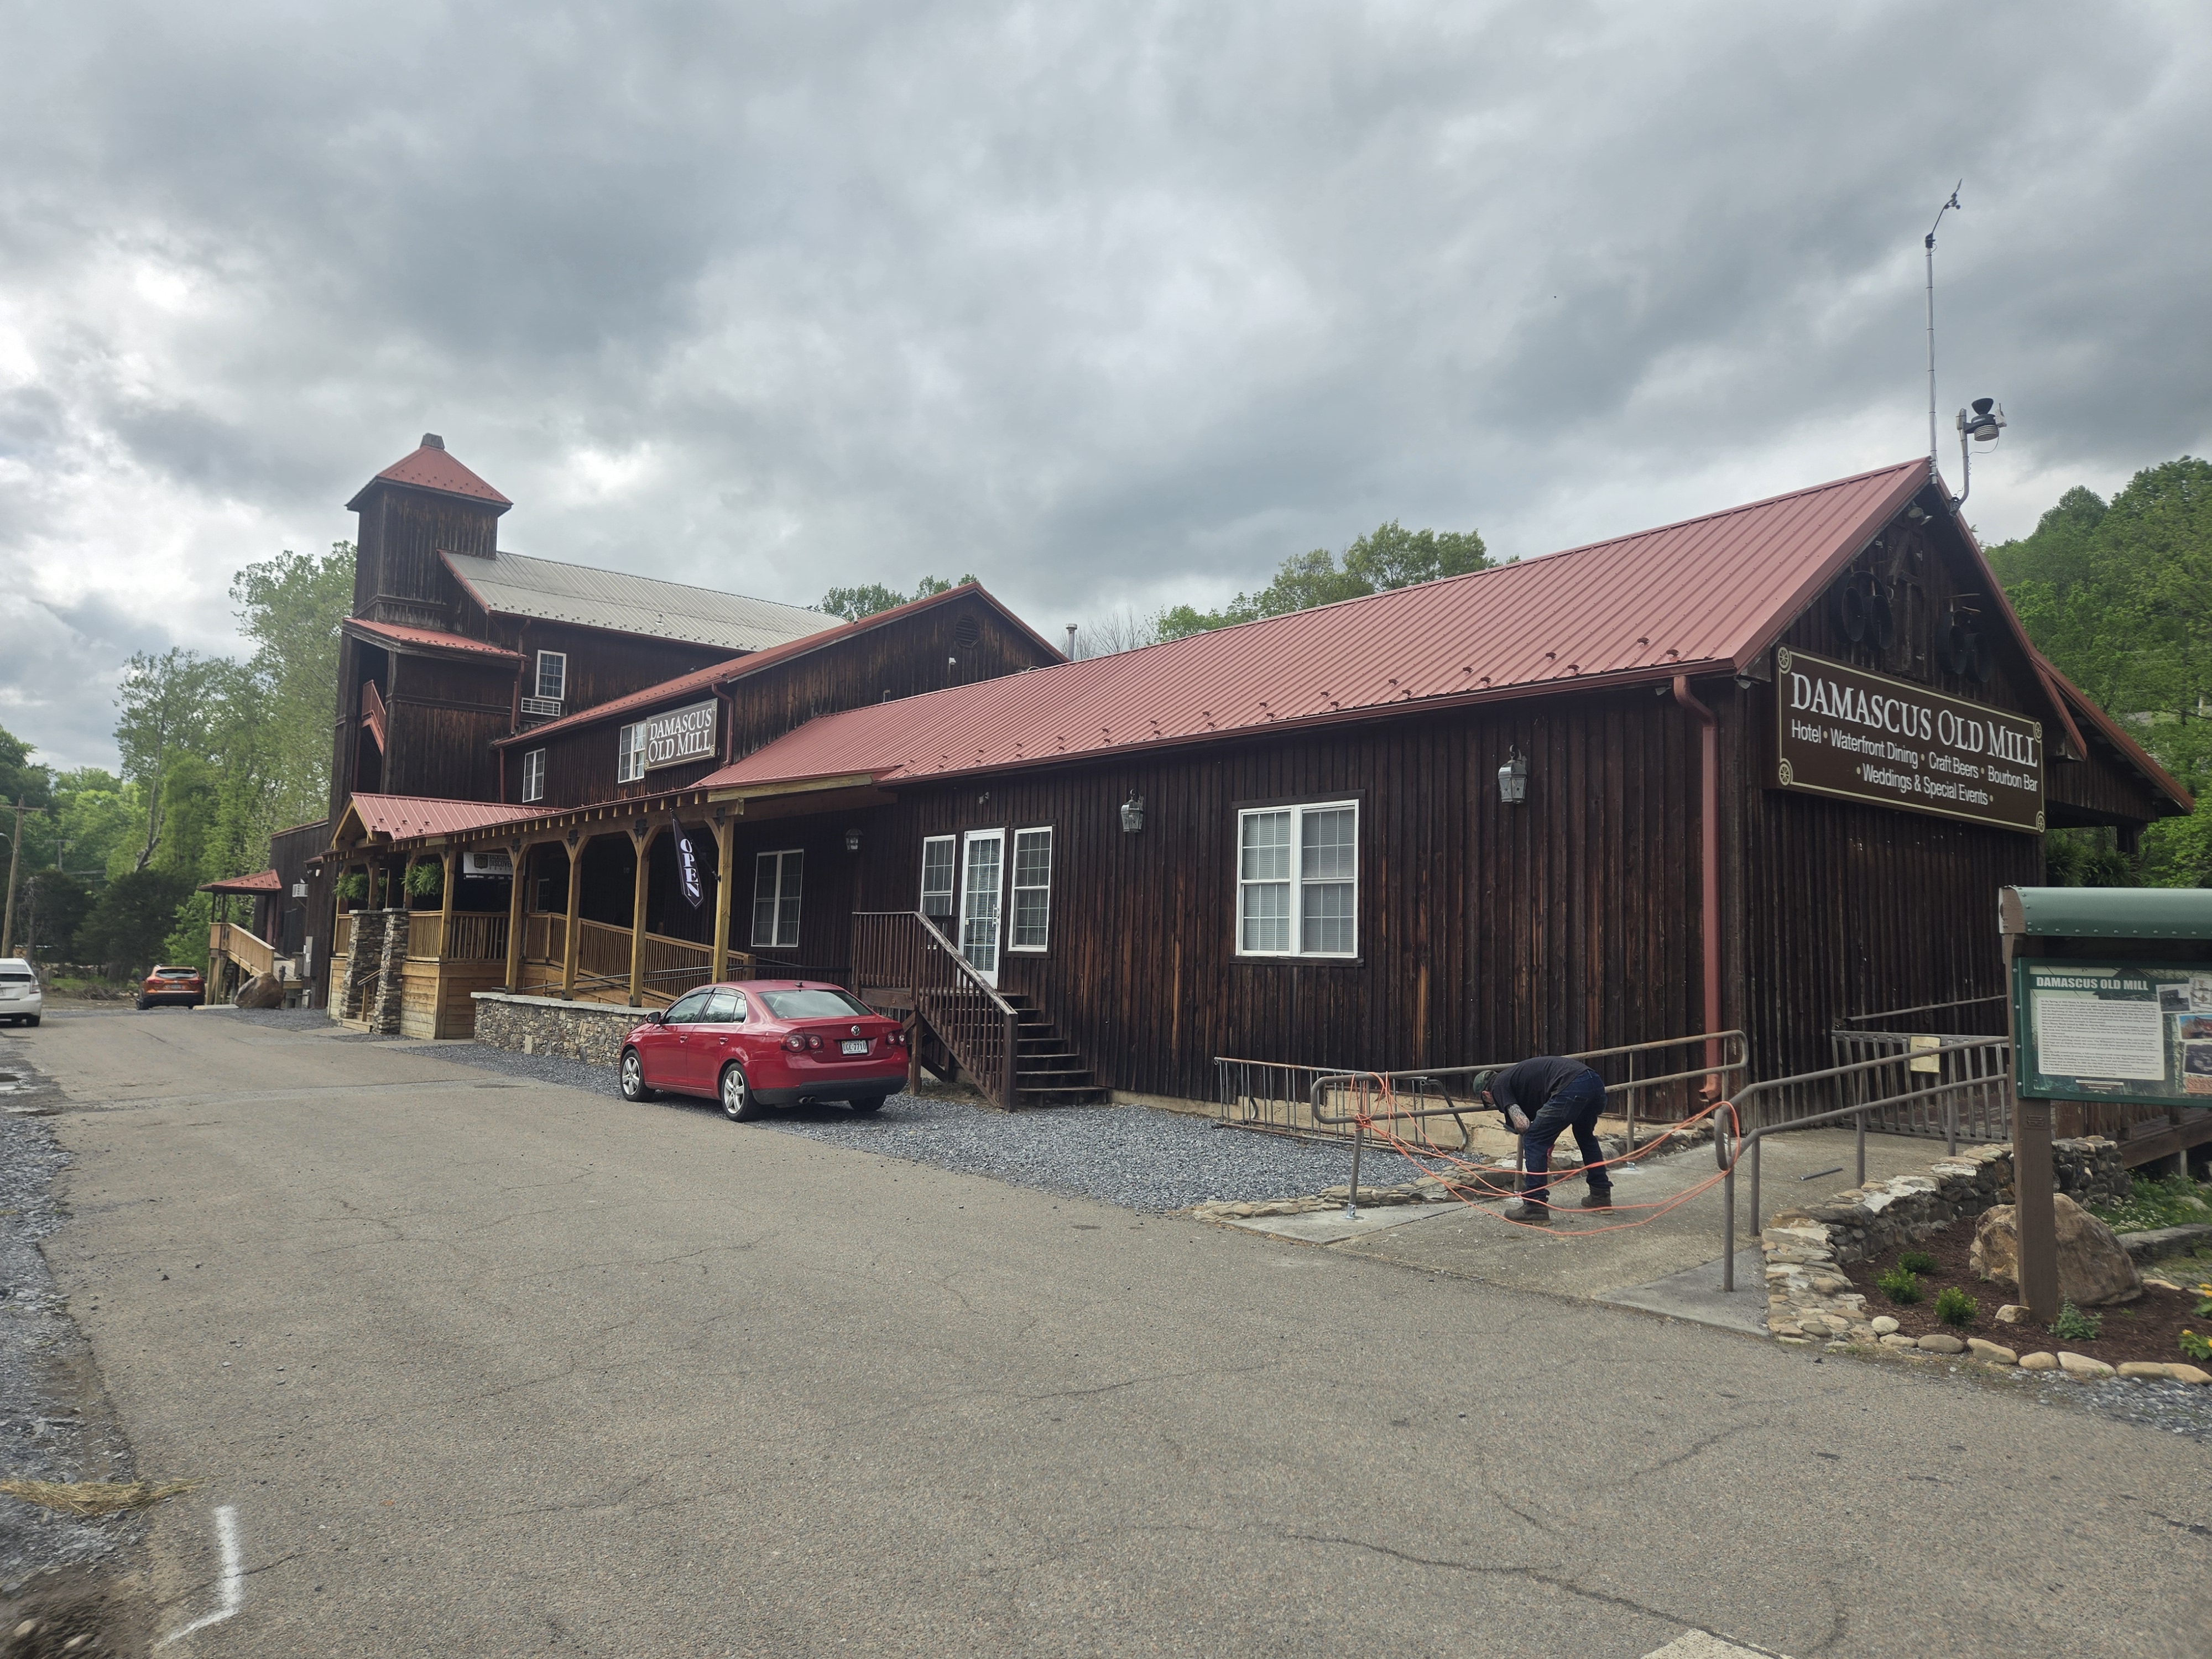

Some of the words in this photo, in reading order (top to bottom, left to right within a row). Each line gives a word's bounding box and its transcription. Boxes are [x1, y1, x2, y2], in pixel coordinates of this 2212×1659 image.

[649, 708, 712, 740] DAMASCUS
[1791, 672, 1931, 740] DAMASCUS
[1938, 709, 1983, 753] OLD
[1987, 721, 2037, 767] MILL
[648, 738, 675, 763] OLD
[676, 729, 711, 757] MILL
[1792, 718, 1822, 743] Hotel
[1830, 727, 1885, 758] Waterfront
[1887, 741, 1918, 769] Dining
[1929, 752, 1952, 773] Craft
[1953, 757, 1979, 779] Beers
[1987, 765, 2022, 789] Bourbon
[2023, 774, 2038, 792] Bar
[1862, 763, 1912, 794] Weddings
[1914, 774, 1922, 792] &
[1923, 776, 1957, 799] Special
[1958, 784, 1989, 806] Events
[680, 838, 700, 898] OPEN
[2036, 977, 2098, 989] DAMASCUS
[2100, 979, 2121, 990] OLD
[2123, 980, 2149, 990] MILL
